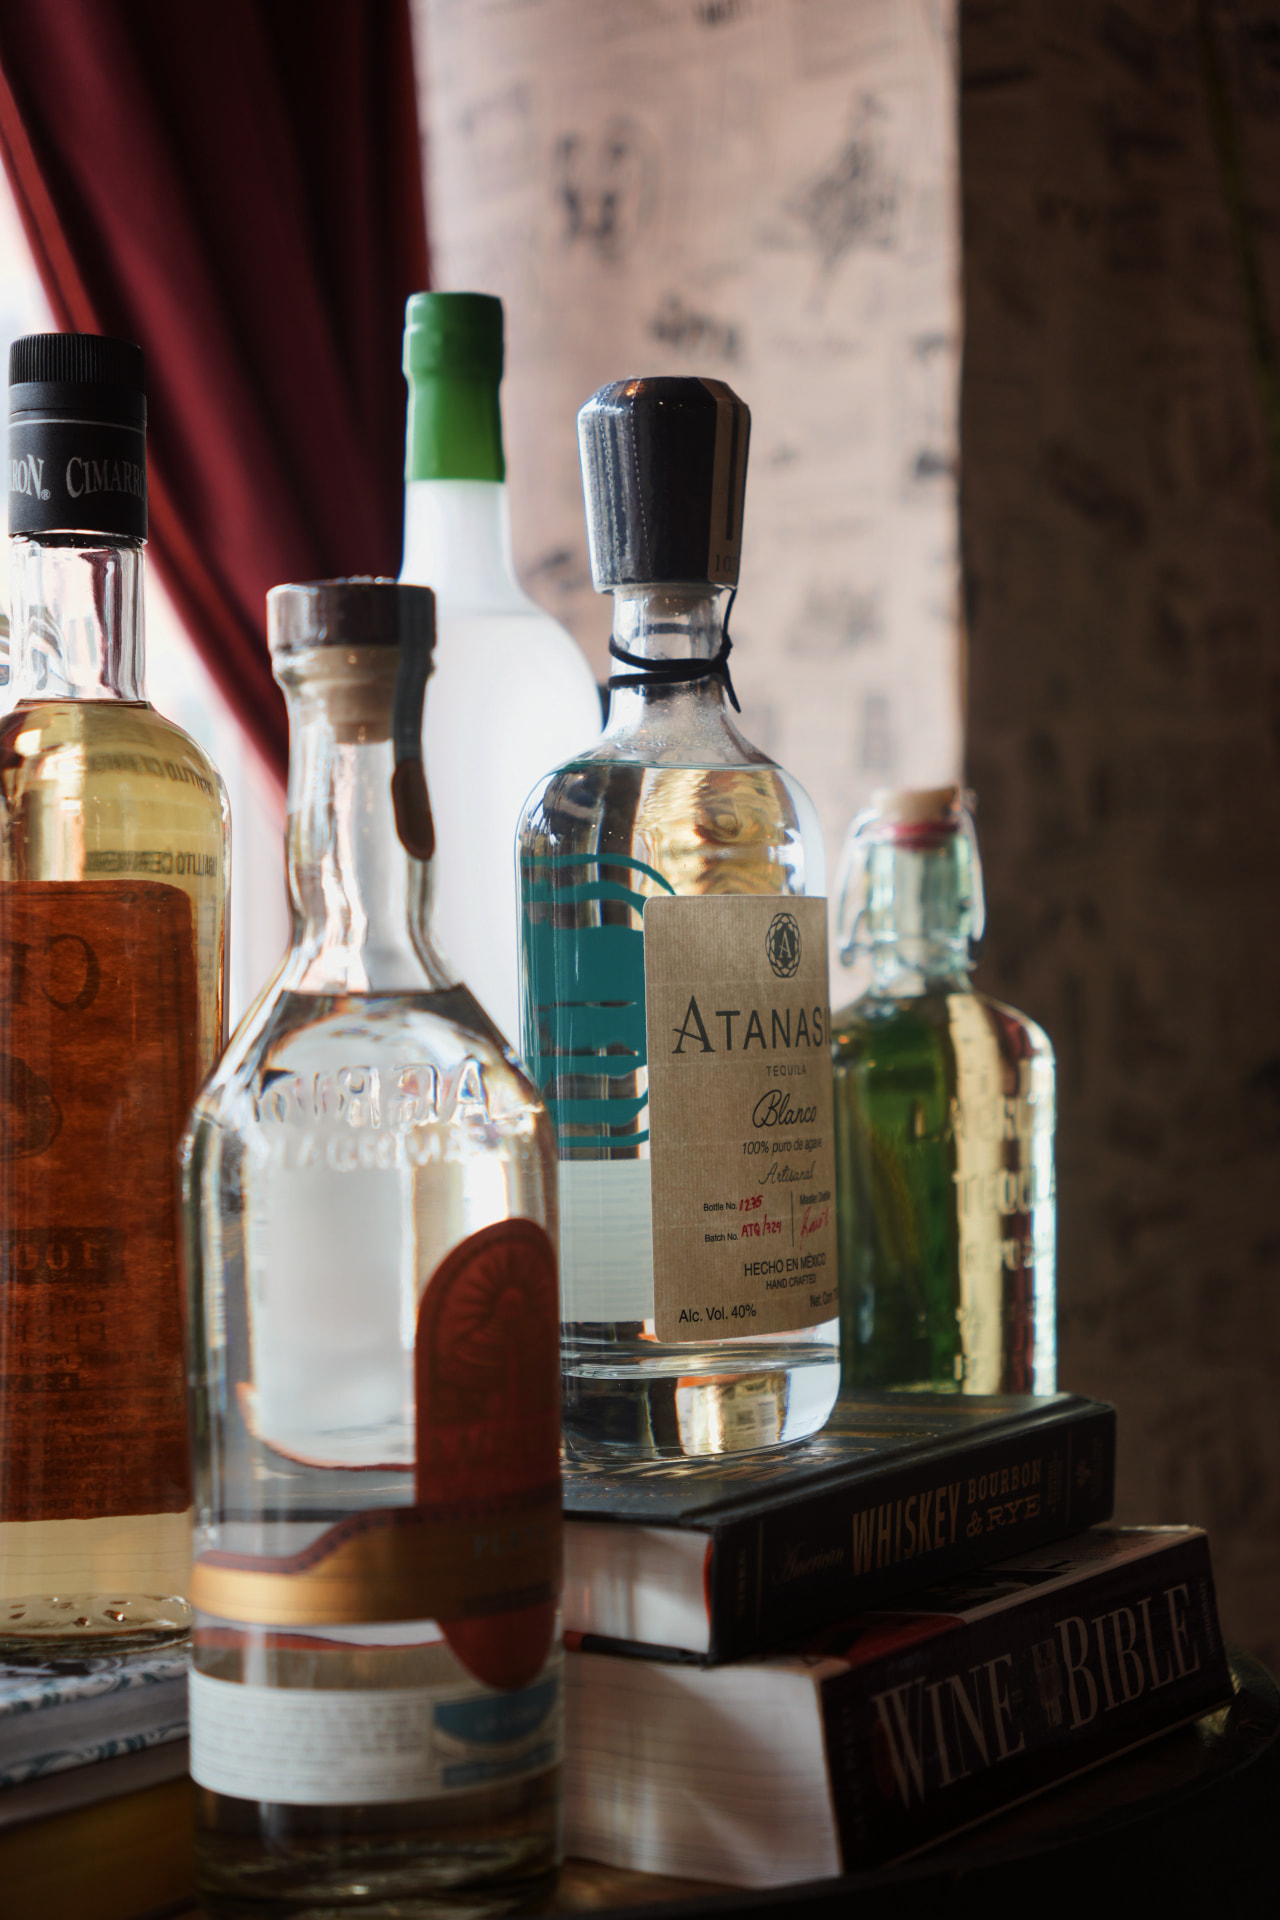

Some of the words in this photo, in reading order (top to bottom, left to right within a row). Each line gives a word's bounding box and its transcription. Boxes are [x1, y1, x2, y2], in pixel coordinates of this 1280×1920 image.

[66, 456, 146, 501] CIMARRO
[672, 995, 831, 1054] ATANASI
[766, 1064, 807, 1077] TEQUILA
[752, 1089, 817, 1128] Blanco
[742, 1140, 769, 1156] 100%
[772, 1141, 792, 1156] puro
[794, 1138, 803, 1151] de
[758, 1160, 816, 1185] Artisanal
[703, 1202, 724, 1212] Bottle
[725, 1202, 737, 1211] No.
[704, 1233, 725, 1243] Batch
[727, 1232, 739, 1241] No.
[744, 1258, 784, 1277] HECHO
[786, 1257, 799, 1272] EN
[766, 1278, 787, 1290] HAND
[789, 1273, 816, 1288] CRAFTED
[678, 1308, 703, 1323] Alc.
[705, 1305, 728, 1321] Vol.
[730, 1303, 757, 1319] 40%
[852, 1482, 961, 1576] WHISKEY
[967, 1458, 1043, 1501] BOURBON
[966, 1510, 983, 1538] &
[986, 1493, 1041, 1532] RYE
[872, 1653, 1027, 1811] WINE
[1055, 1584, 1200, 1731] BIBLE
